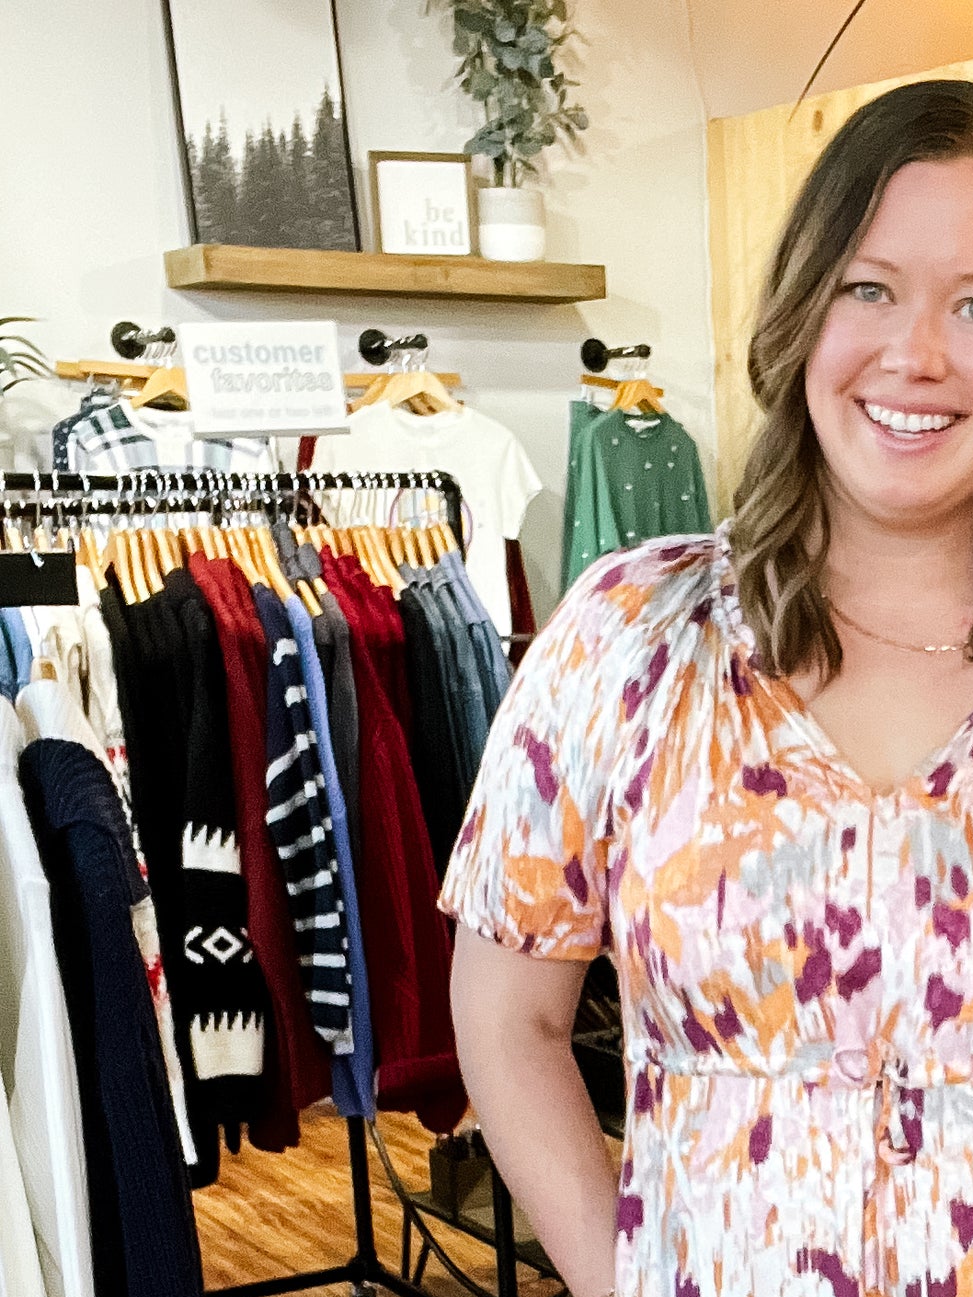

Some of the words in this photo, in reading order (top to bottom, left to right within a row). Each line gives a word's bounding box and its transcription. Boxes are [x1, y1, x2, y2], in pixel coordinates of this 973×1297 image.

[424, 197, 454, 222] be
[403, 219, 464, 247] kind
[193, 341, 325, 365] customer
[210, 366, 335, 394] favorites
